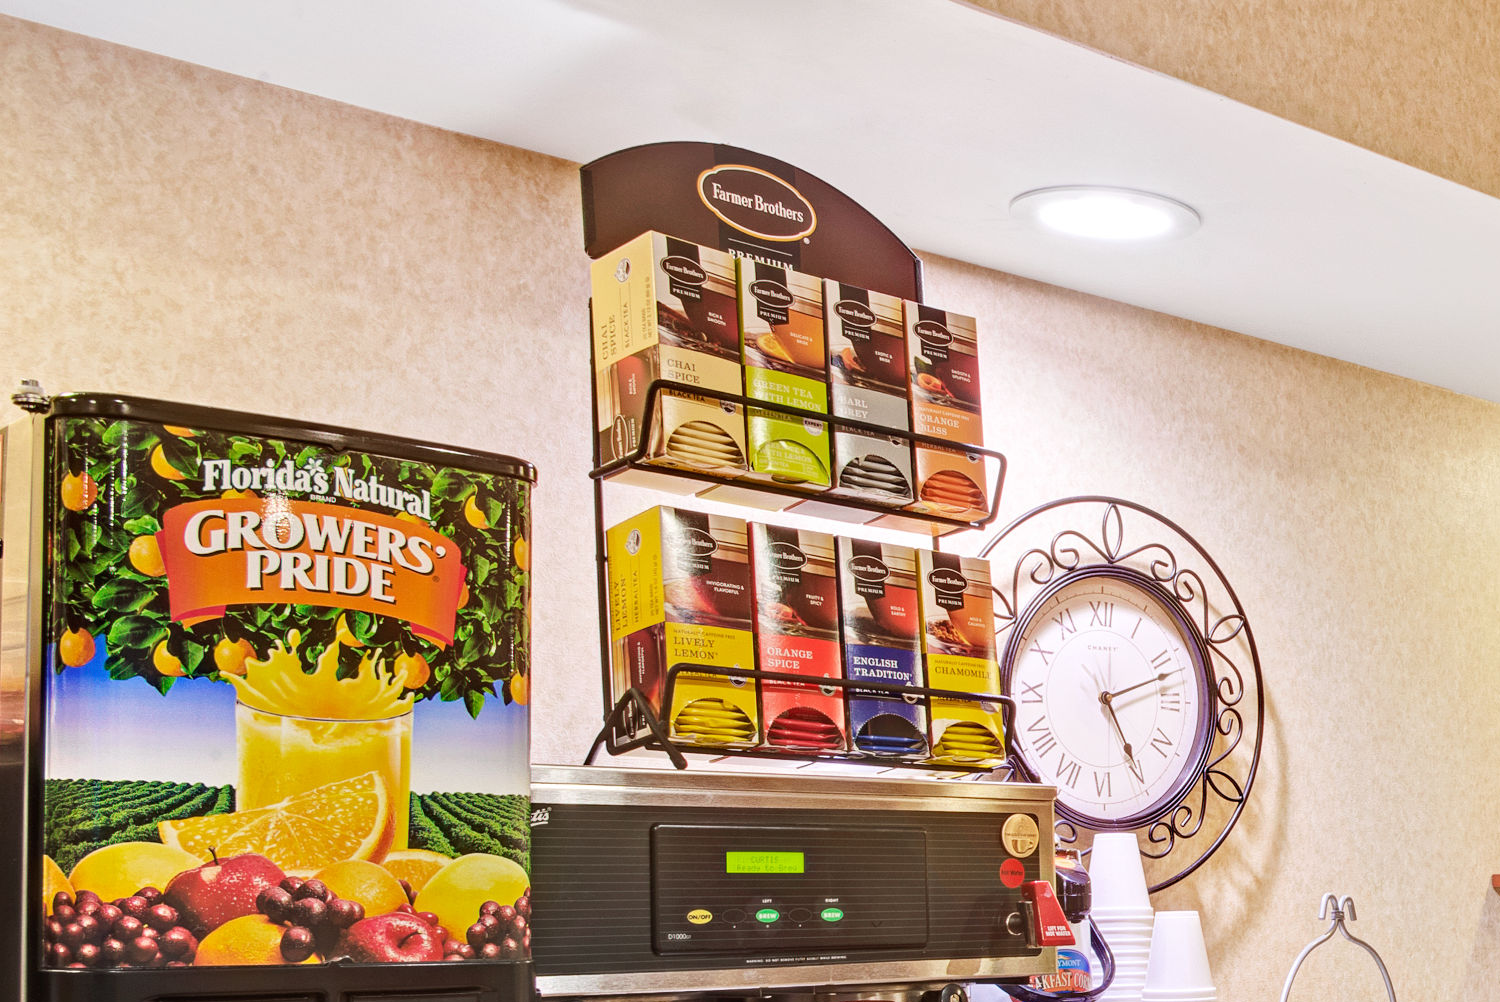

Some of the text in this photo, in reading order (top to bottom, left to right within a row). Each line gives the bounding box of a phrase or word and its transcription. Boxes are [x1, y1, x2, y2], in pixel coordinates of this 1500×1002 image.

[712, 182, 804, 223] Farmer Brothers
[672, 288, 701, 299] PREMIUM
[760, 311, 787, 321] PREMIUM
[608, 315, 618, 356] SPICE
[844, 330, 870, 340] PREMIUM
[600, 325, 609, 360] CHAI
[923, 350, 947, 359] PREMIUM
[667, 358, 697, 372] CHAI
[667, 370, 701, 384] SPICE
[792, 388, 814, 400] TEA
[786, 396, 822, 413] LEMON
[919, 414, 960, 429] ORANGE
[920, 424, 948, 436] BLISS
[203, 458, 432, 521] Florida's Natural
[309, 494, 337, 504] BRAND
[184, 509, 447, 576] GROWERS'
[246, 550, 397, 604] PRIDE
[857, 587, 884, 595] PREMIUM
[938, 599, 963, 607] PREMIUM
[674, 637, 715, 648] LIVELY
[766, 647, 813, 660] ORANGE
[767, 659, 800, 670] SPICE
[853, 656, 899, 668] ENGLISH
[935, 666, 992, 680] CHAMOMILE
[750, 855, 779, 864] CURTIS
[736, 864, 762, 873] Ready
[778, 864, 798, 872] Brew
[688, 912, 712, 921] ON/OFF
